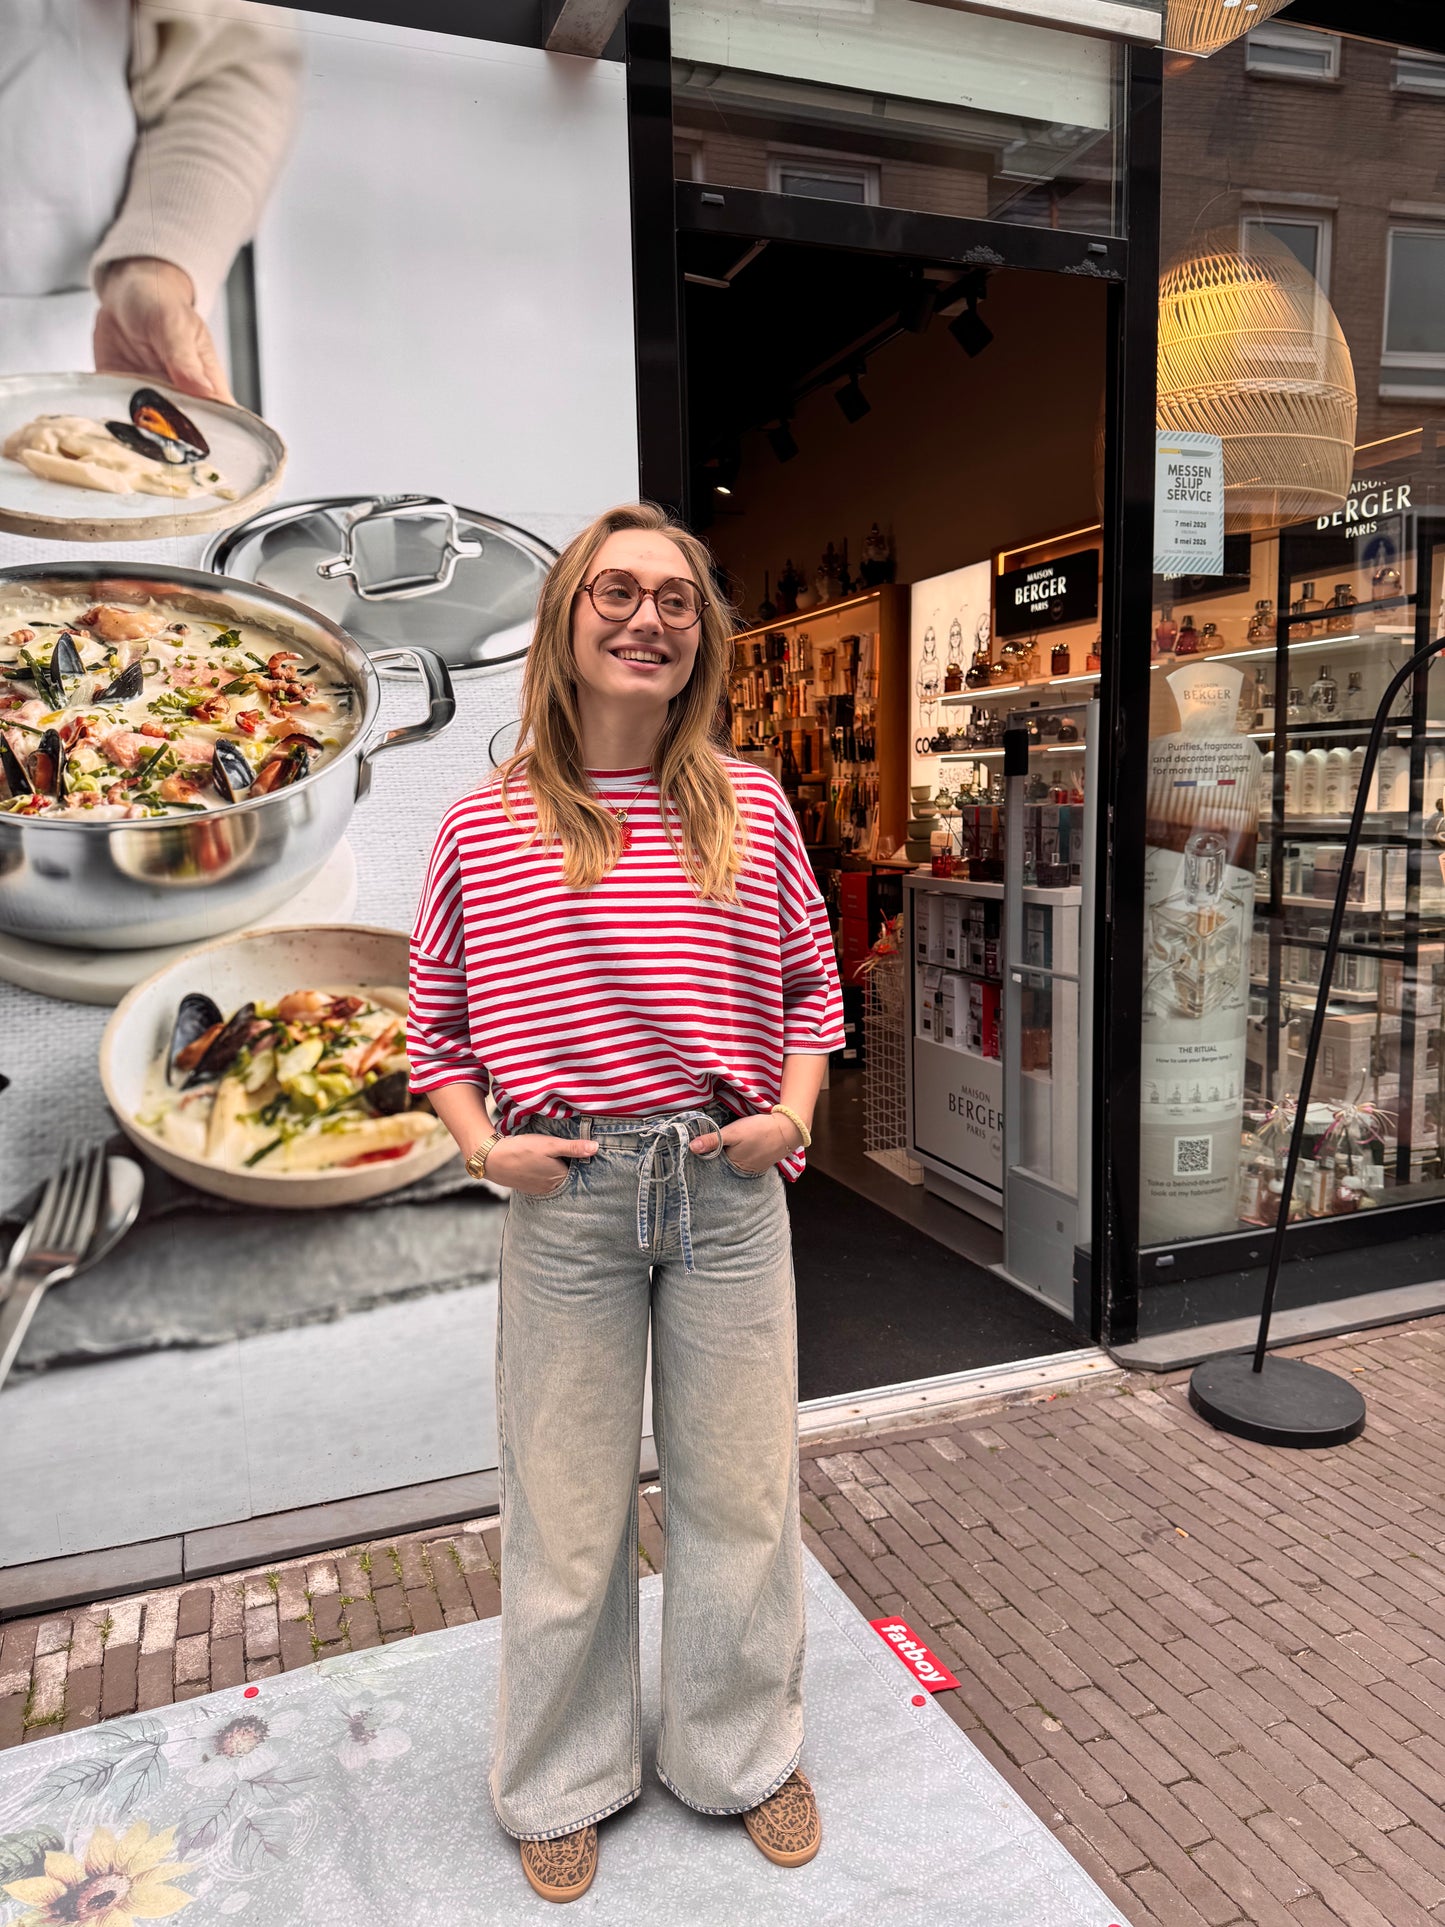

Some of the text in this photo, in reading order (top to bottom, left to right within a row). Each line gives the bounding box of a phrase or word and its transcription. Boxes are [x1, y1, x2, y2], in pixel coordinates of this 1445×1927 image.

[1167, 464, 1211, 478] MESSEN
[1174, 477, 1203, 489] SLIJP
[1167, 489, 1212, 502] SERVICE
[1345, 521, 1378, 539] PARIS
[1026, 568, 1054, 582] MAISON
[1014, 576, 1067, 606] BERGER
[1030, 600, 1049, 613] PARIS
[1183, 689, 1231, 700] BERGER
[1168, 742, 1243, 752] Purifies, fragrances
[1153, 755, 1172, 763] and
[1174, 754, 1216, 763] decorates
[1217, 755, 1233, 763] your
[1153, 767, 1168, 775] for
[1195, 766, 1213, 774] than
[1194, 1045, 1216, 1053] RITUAL
[962, 1085, 990, 1103] MAISON
[948, 1092, 1004, 1132] BERGER
[966, 1122, 986, 1139] PARIS
[880, 1624, 947, 1682] fatboy
